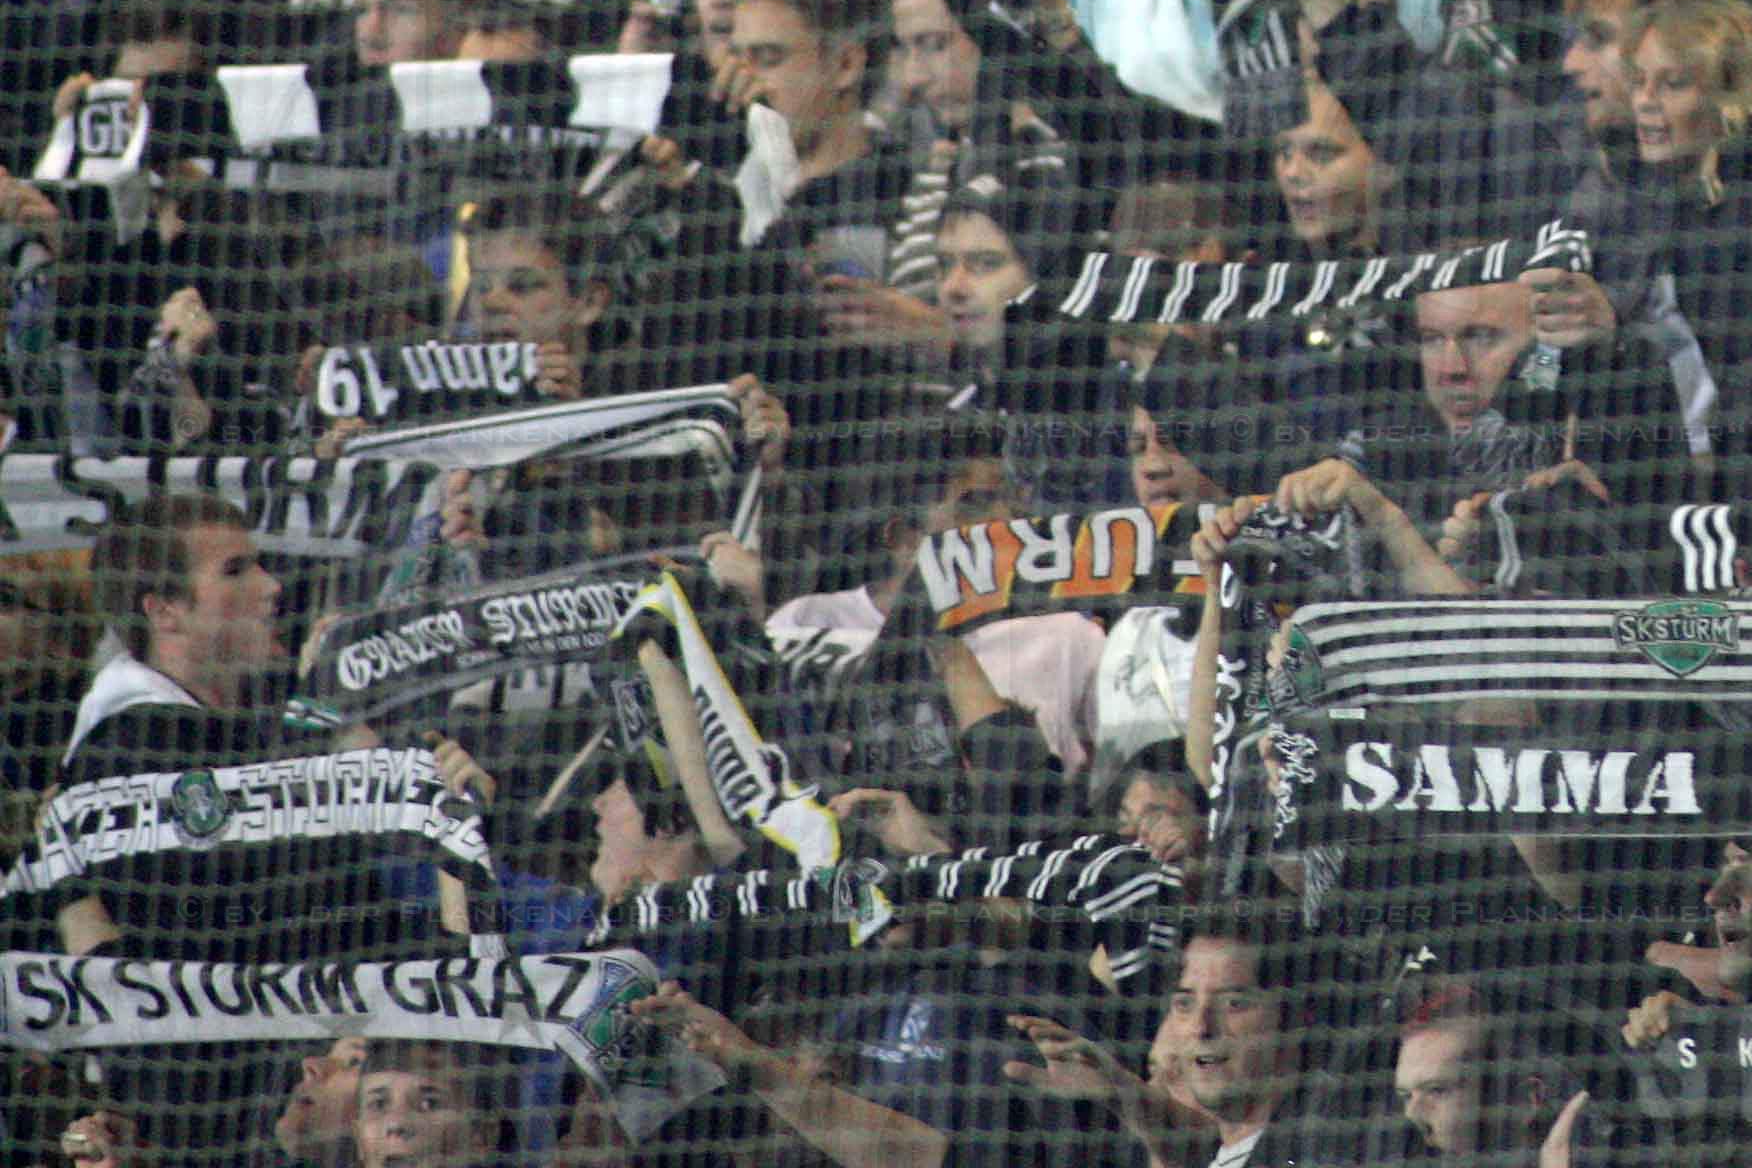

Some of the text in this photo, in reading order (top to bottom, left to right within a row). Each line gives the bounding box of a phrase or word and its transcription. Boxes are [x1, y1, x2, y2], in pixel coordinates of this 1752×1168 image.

[1341, 740, 1704, 817] SAMMA
[14, 954, 592, 1031] SK STURM GRAZ
